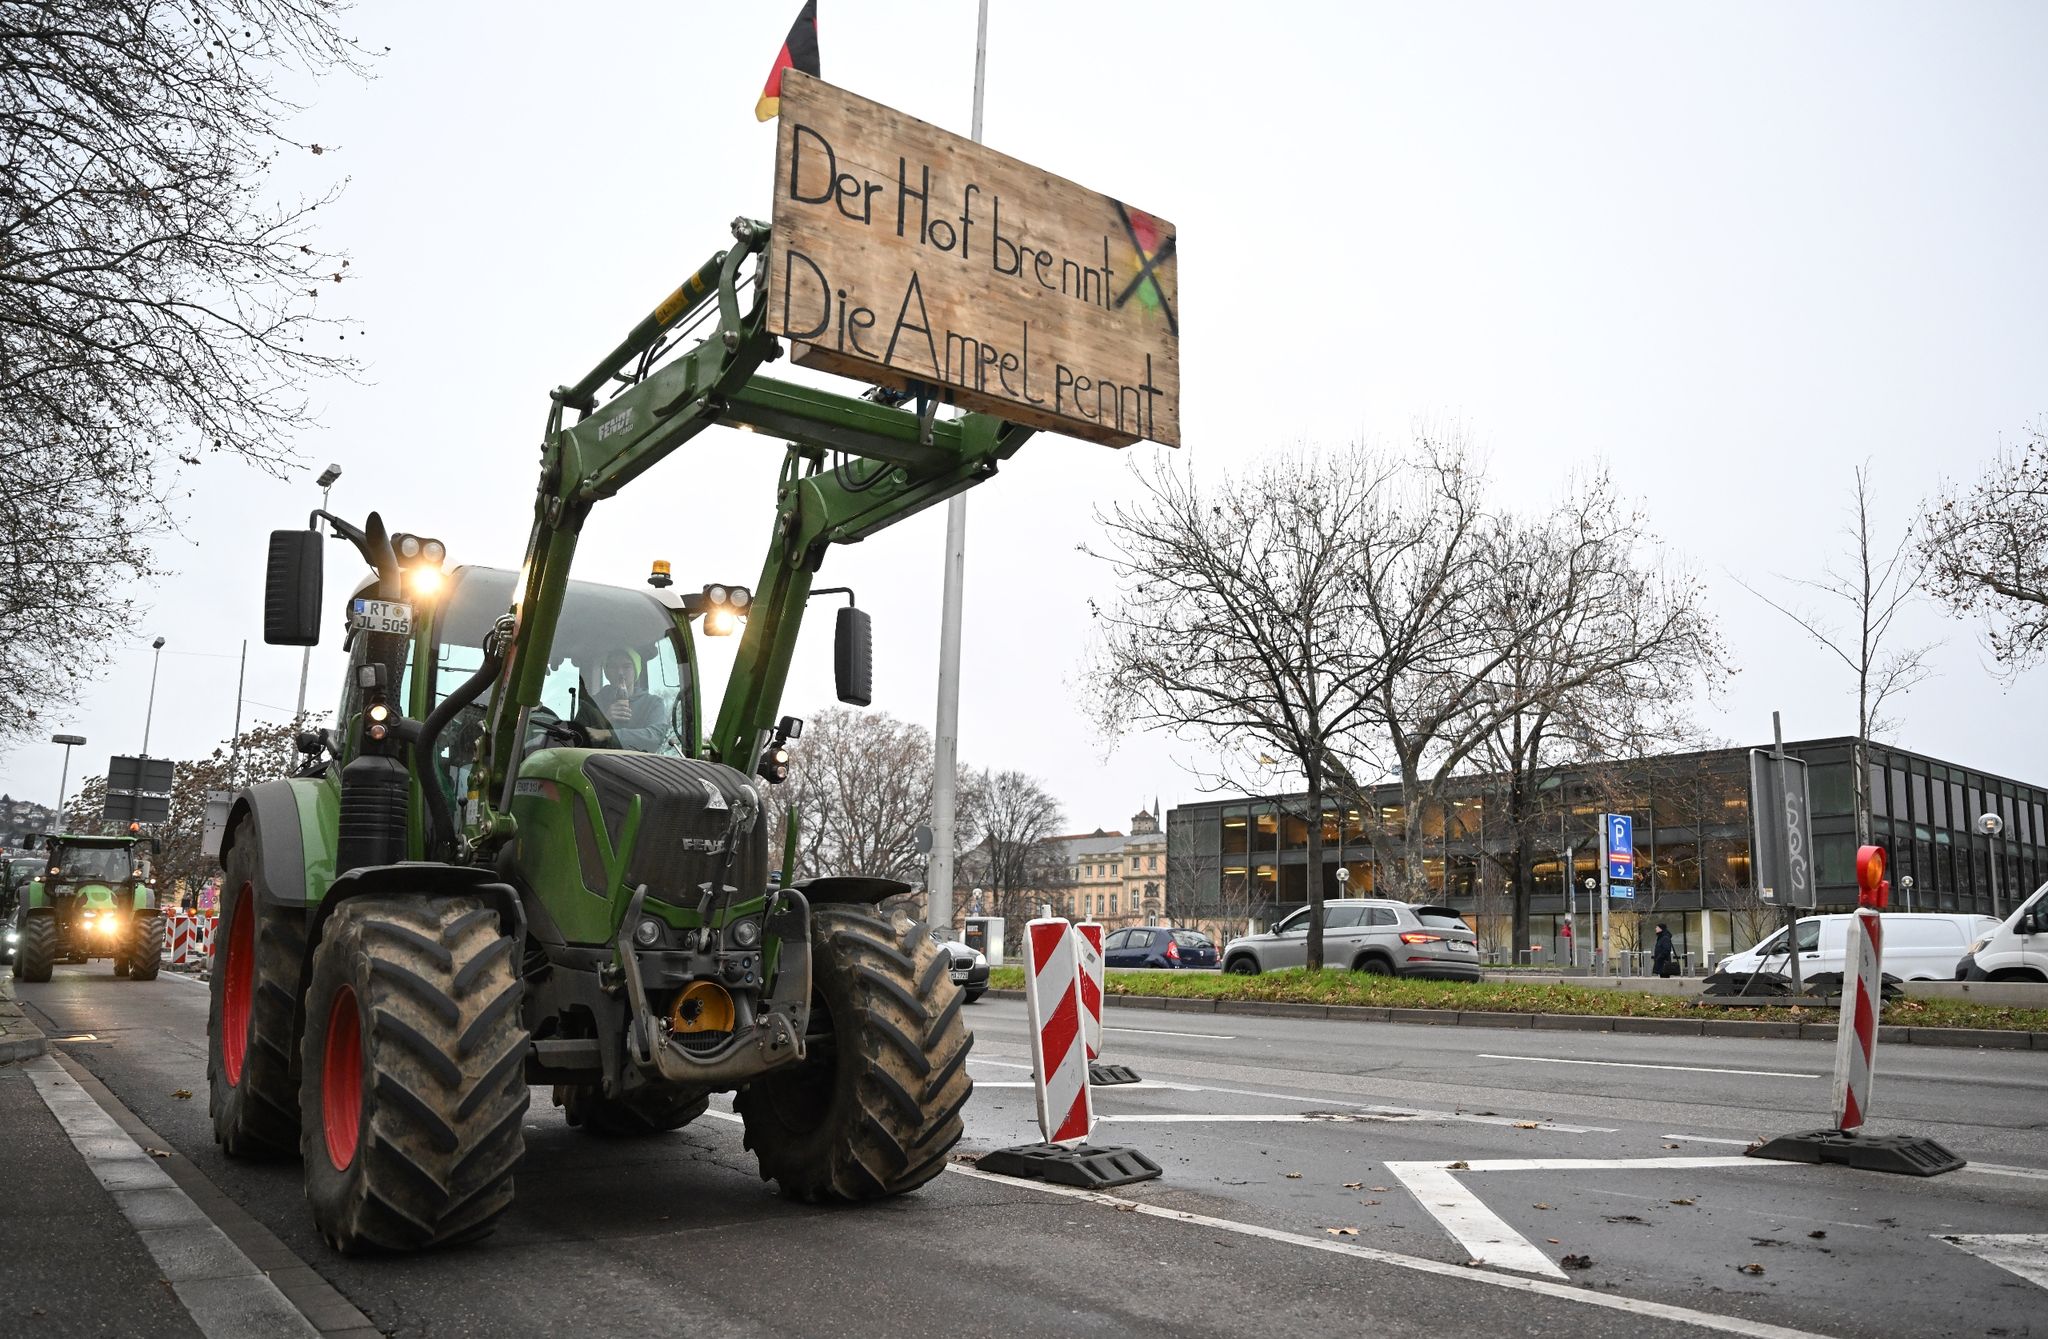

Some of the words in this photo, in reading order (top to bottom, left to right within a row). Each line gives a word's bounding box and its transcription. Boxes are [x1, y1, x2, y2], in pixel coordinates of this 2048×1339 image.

[790, 123, 883, 225] Der
[896, 157, 980, 260] Hof
[993, 195, 1115, 312] brennt
[783, 249, 879, 360] Die
[884, 270, 1045, 404] Ampel
[1055, 353, 1164, 440] pennt
[598, 407, 633, 441] FENDT
[370, 602, 389, 616] RT
[356, 615, 375, 629] JL
[382, 618, 409, 633] 505
[1615, 824, 1624, 845] P
